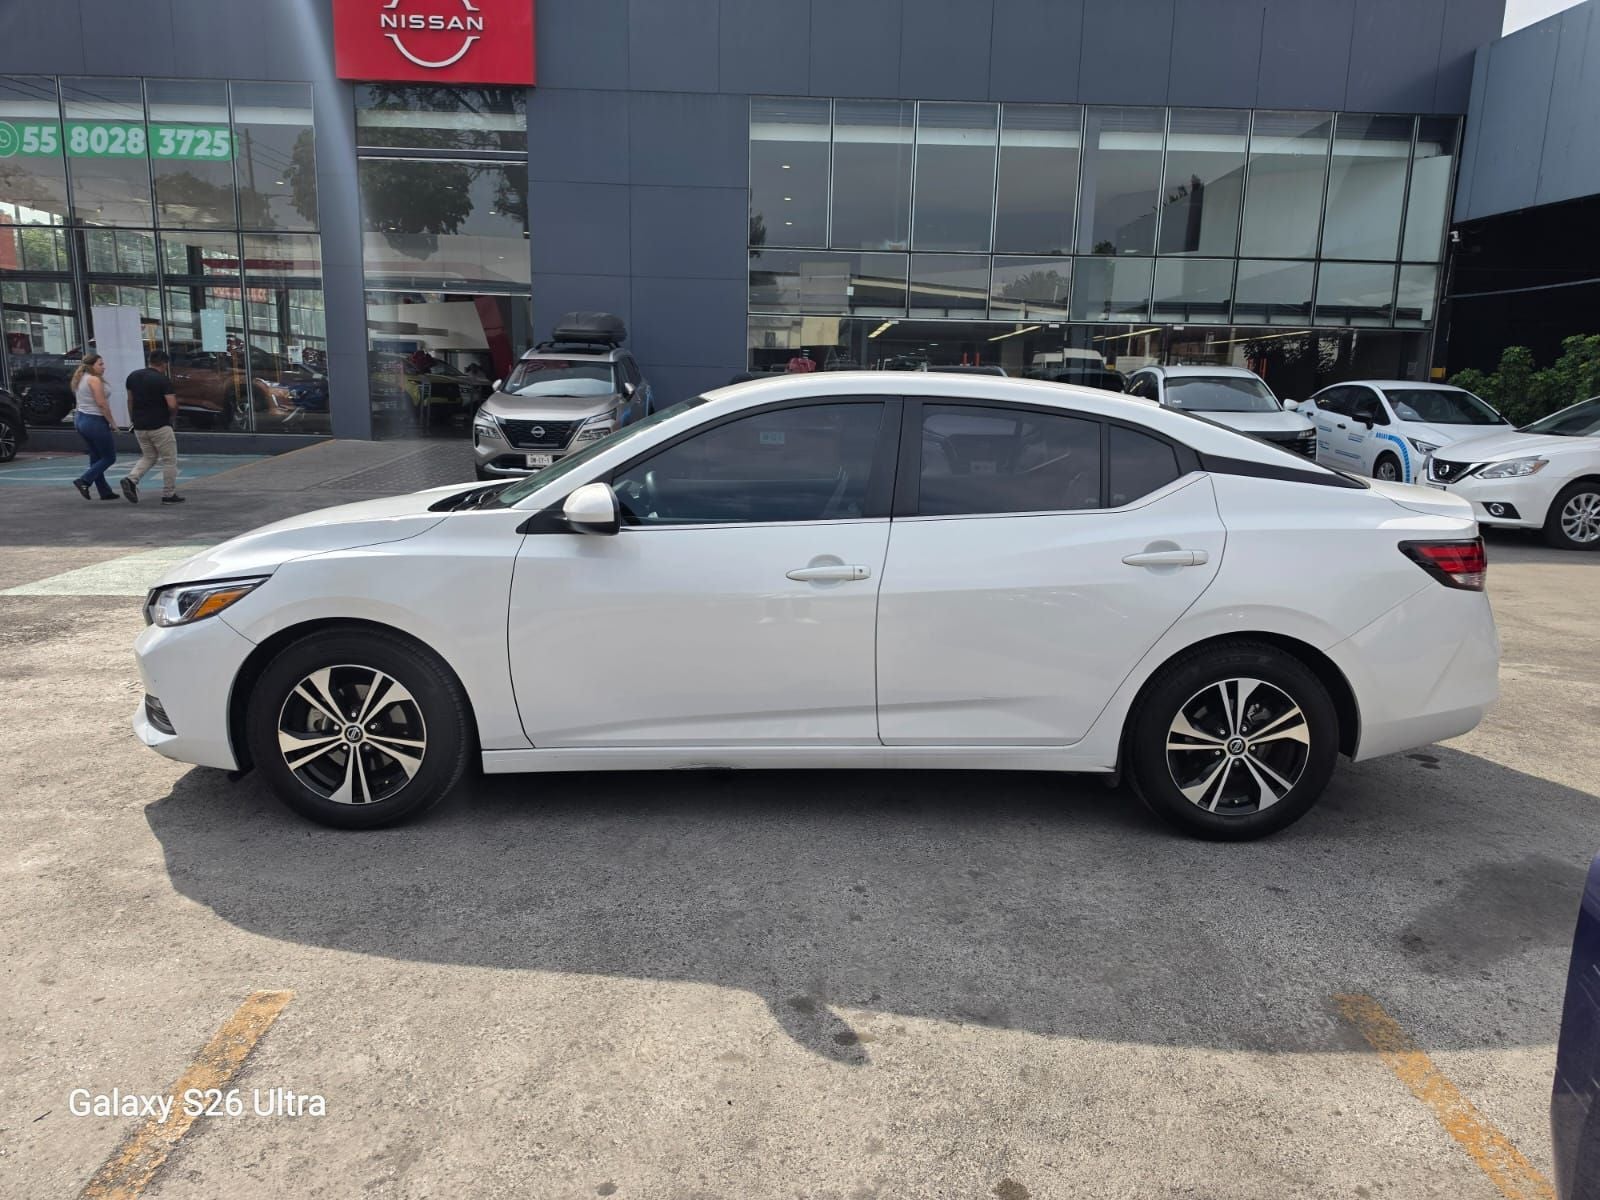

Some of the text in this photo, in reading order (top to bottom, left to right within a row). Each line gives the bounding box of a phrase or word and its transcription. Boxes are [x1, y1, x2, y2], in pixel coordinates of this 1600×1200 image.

[380, 13, 483, 30] NISSAN
[22, 126, 230, 157] 55 8028 3725
